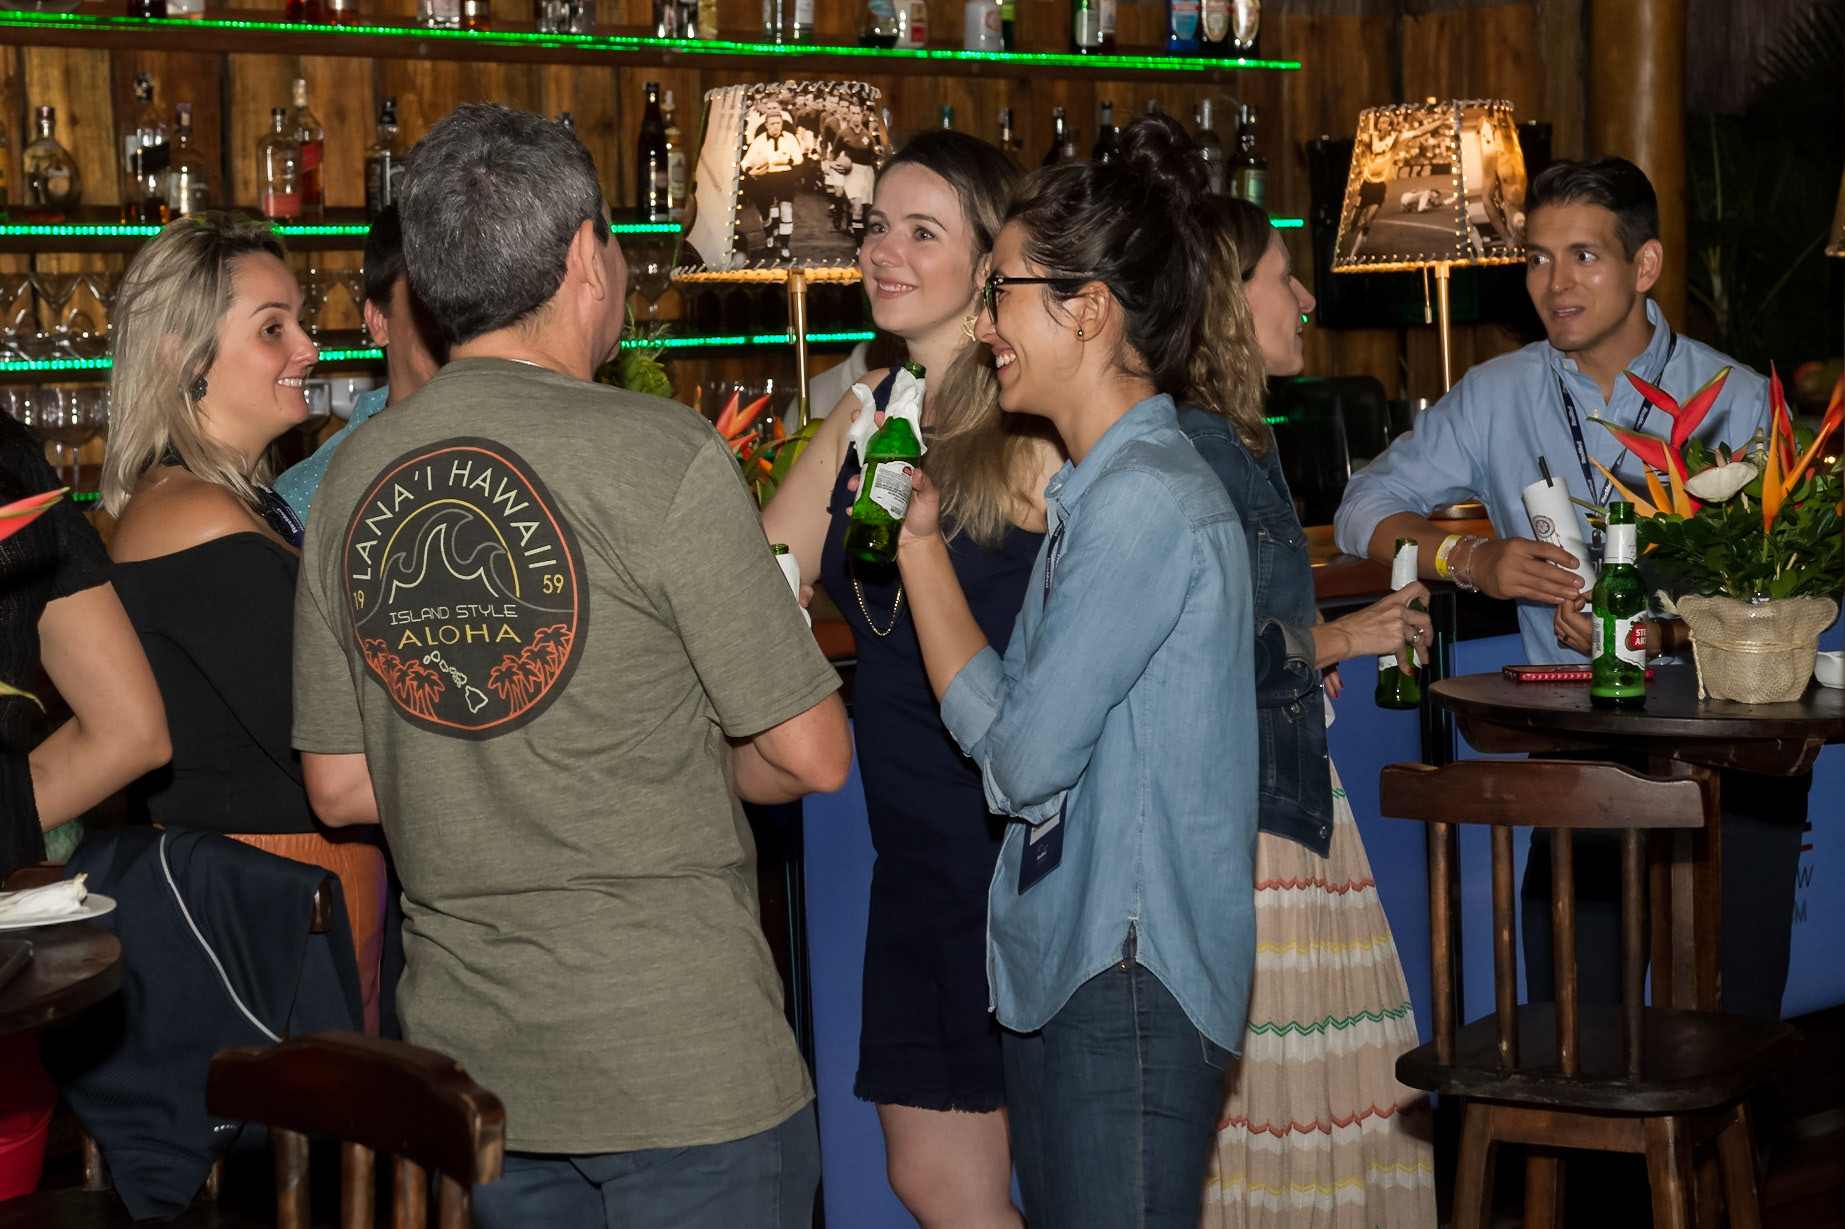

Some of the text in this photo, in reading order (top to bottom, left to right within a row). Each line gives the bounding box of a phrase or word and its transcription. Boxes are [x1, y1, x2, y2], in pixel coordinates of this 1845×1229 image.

[353, 459, 557, 580] LANA'I HAWAII
[542, 573, 565, 595] 59
[353, 589, 366, 610] 19
[389, 603, 519, 626] ISLAND STYLE
[397, 622, 522, 650] ALOHA
